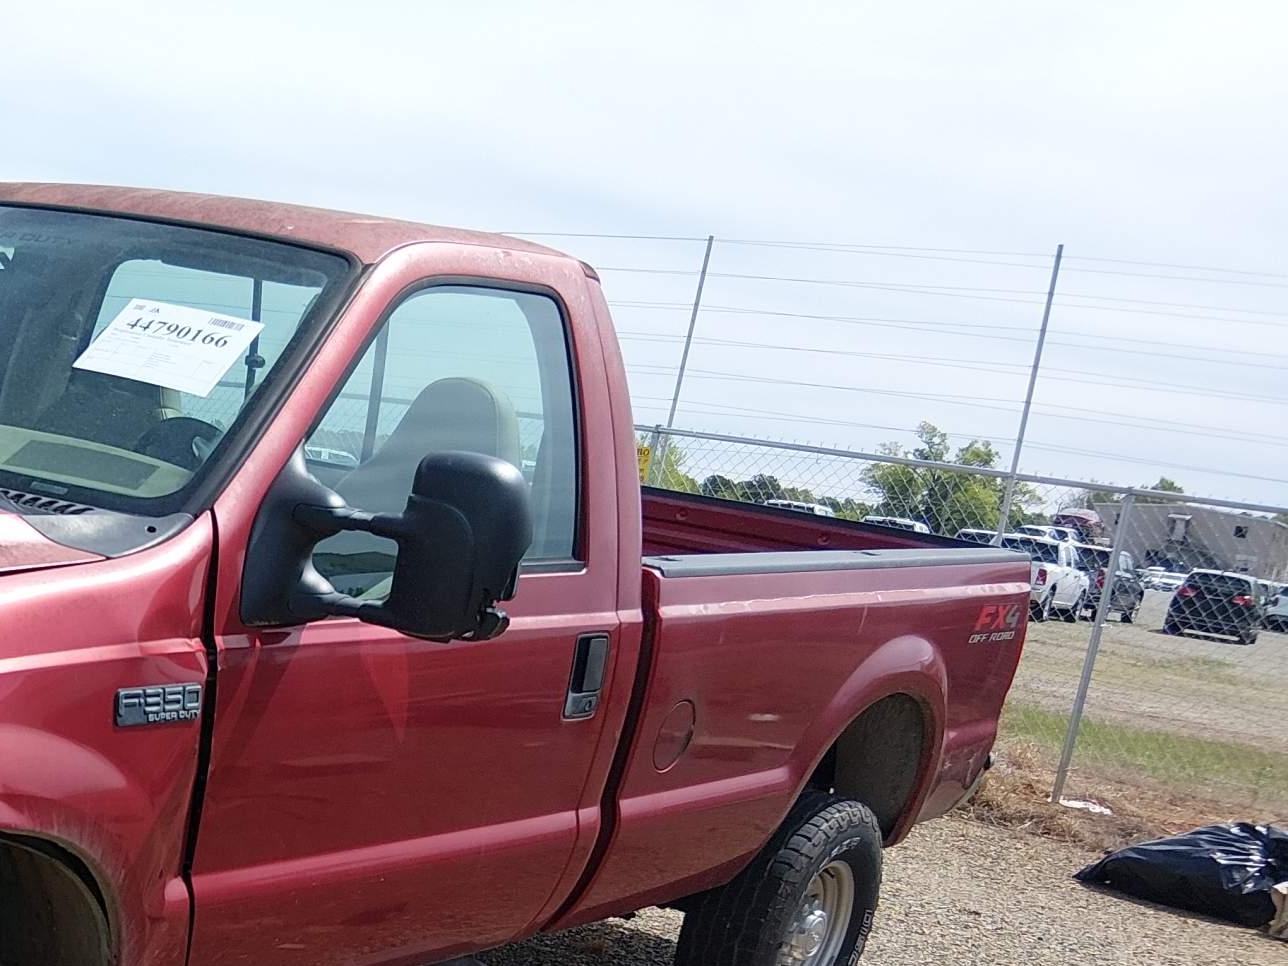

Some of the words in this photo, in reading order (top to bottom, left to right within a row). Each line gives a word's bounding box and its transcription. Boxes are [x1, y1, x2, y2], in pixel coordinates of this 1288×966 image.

[126, 316, 233, 349] 44790166
[974, 604, 1020, 631] FX4
[968, 633, 989, 643] OFF
[988, 631, 1015, 641] ROAD
[117, 685, 202, 721] F350
[148, 712, 178, 722] SUPER
[179, 709, 202, 719] DUTY
